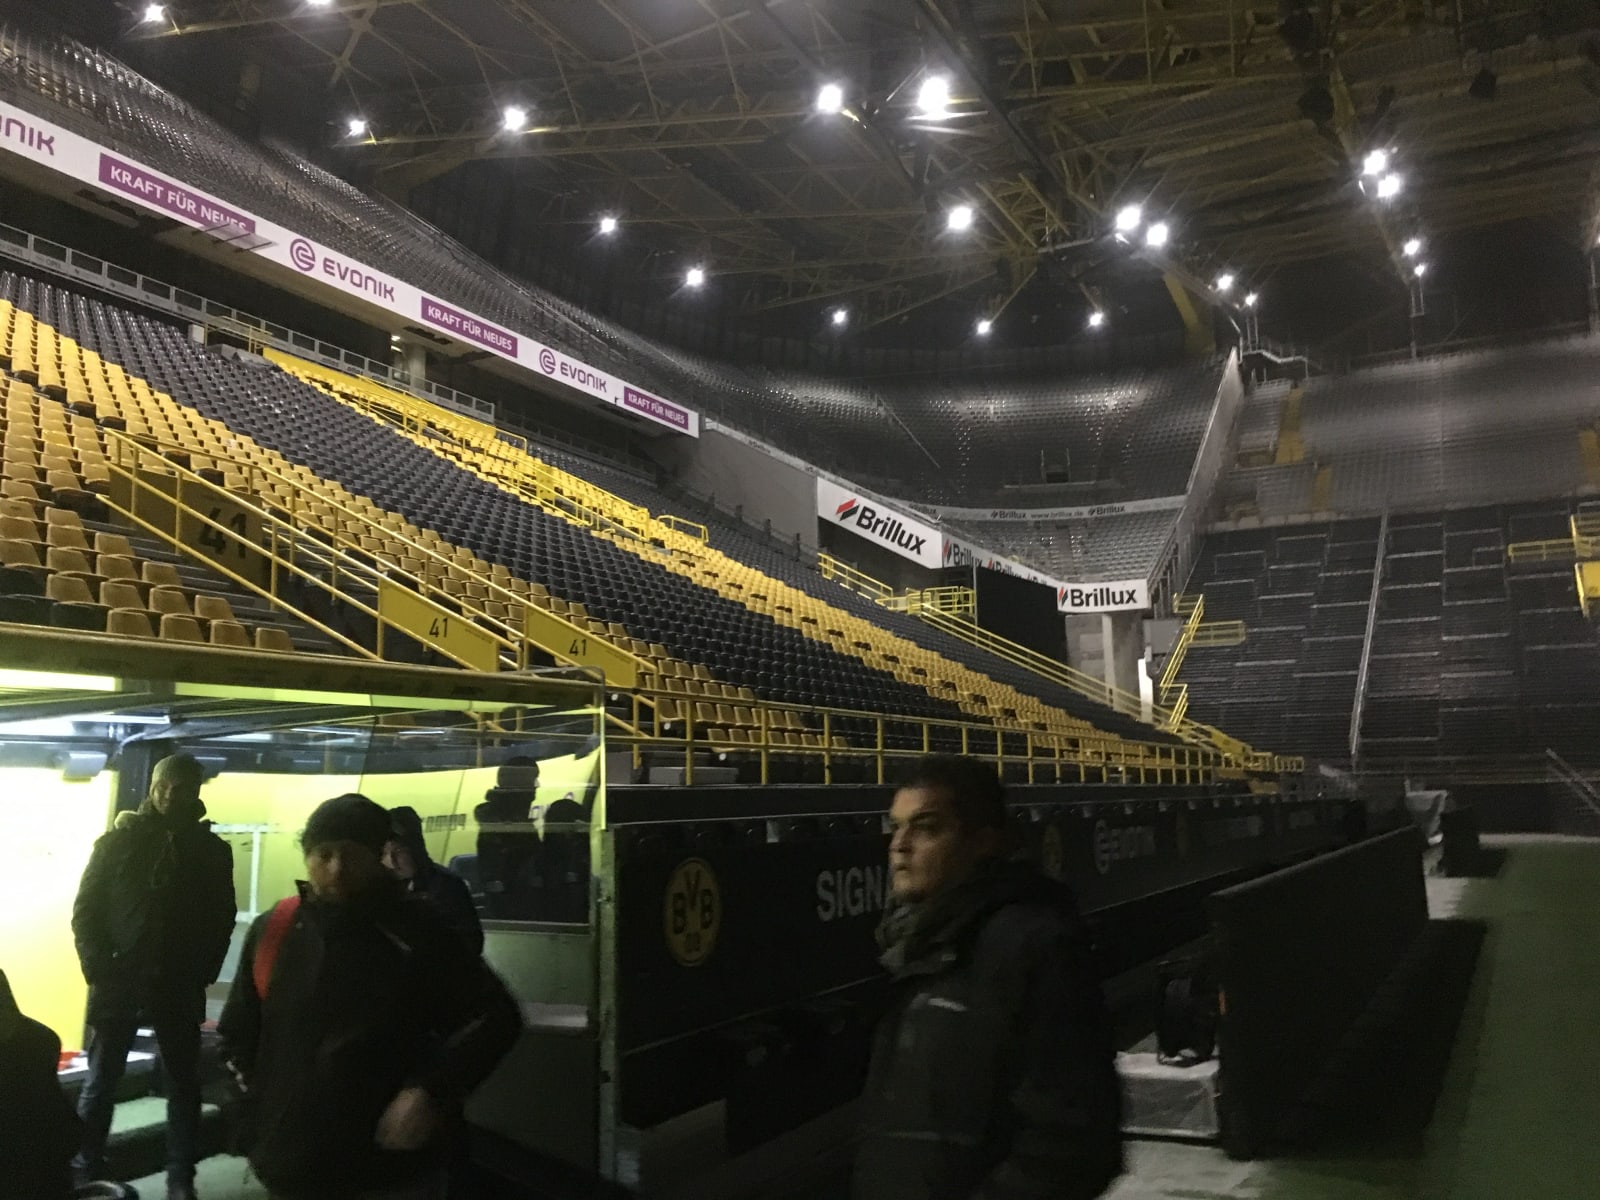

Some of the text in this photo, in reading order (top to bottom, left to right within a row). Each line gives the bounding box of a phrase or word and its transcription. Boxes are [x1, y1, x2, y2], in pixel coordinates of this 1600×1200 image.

[0, 115, 54, 156] NIK
[110, 165, 164, 199] KRAFT
[167, 191, 197, 214] FÜR
[322, 257, 395, 302] EVONIK
[428, 305, 512, 351] KRAFT FÜR NEUES
[560, 361, 607, 393] EVONIK
[628, 392, 685, 425] KRAFT FÜR NEUES
[199, 507, 247, 558] 41
[855, 508, 926, 556] Brillux
[999, 510, 1027, 519] Brillux
[1096, 505, 1126, 515] Brillux
[1069, 585, 1137, 608] Brillux
[429, 616, 448, 639] 41
[569, 638, 587, 657] 41
[672, 869, 713, 934] BVB
[816, 865, 891, 922] SIGN
